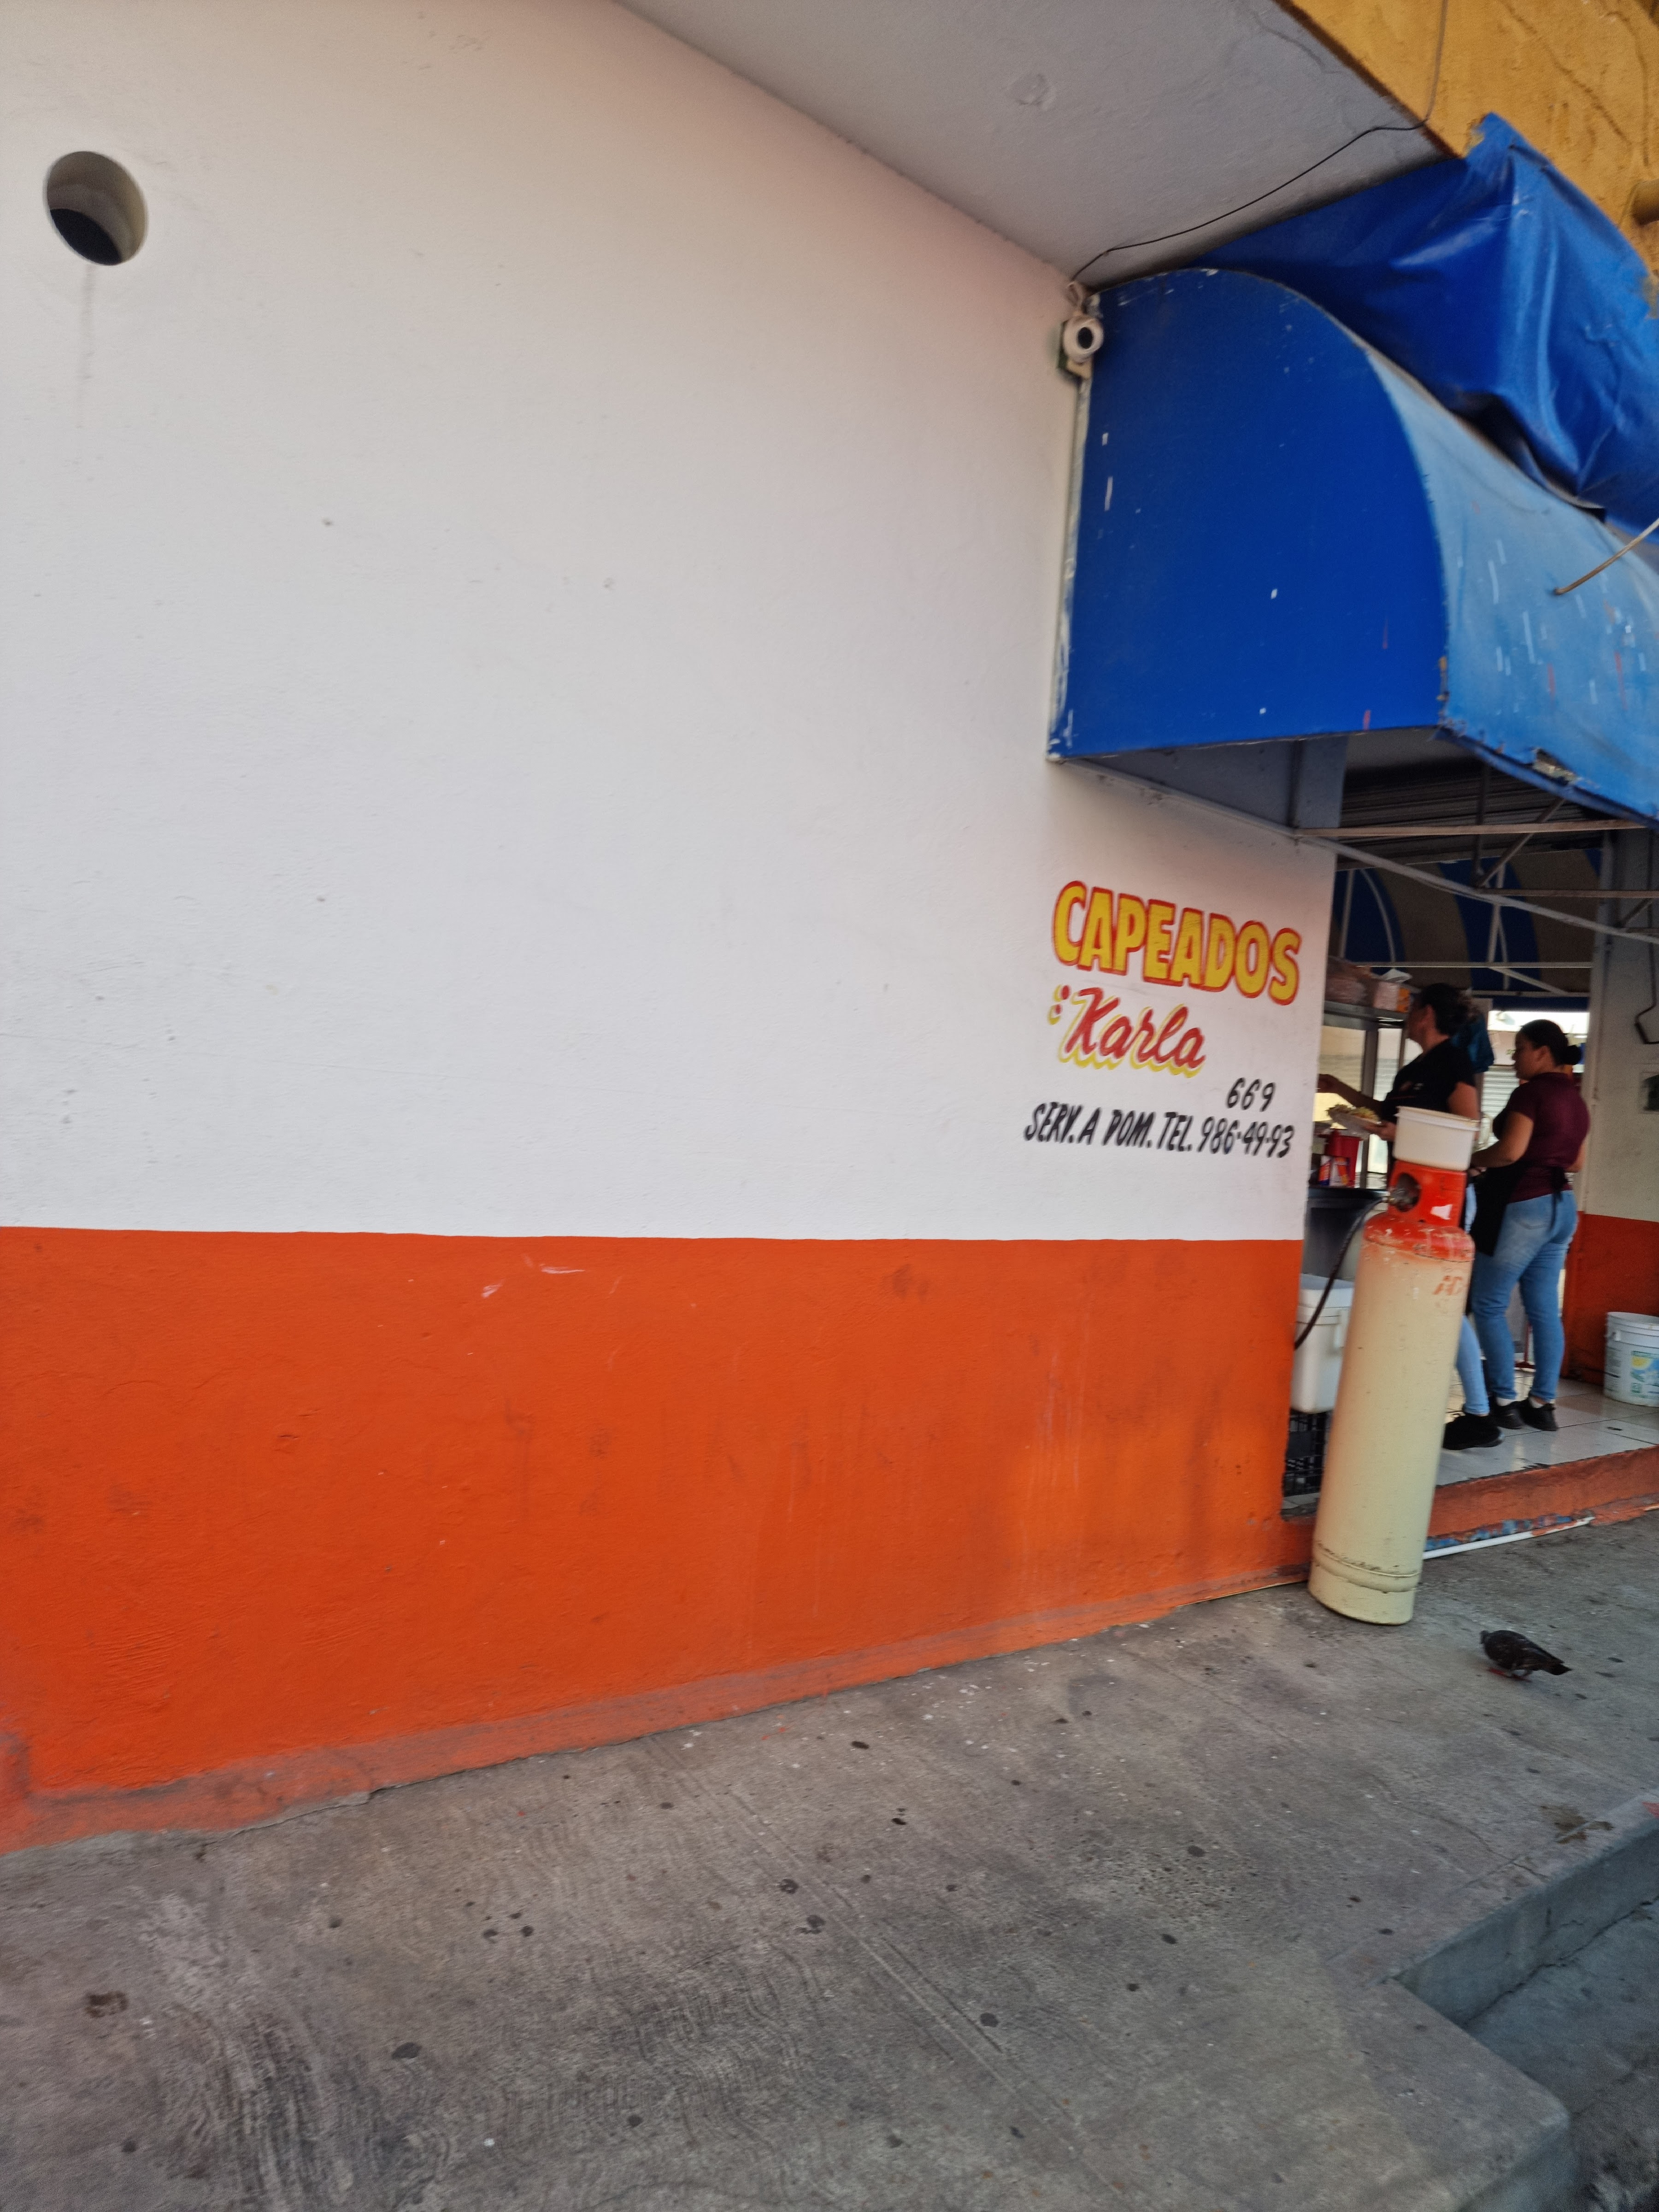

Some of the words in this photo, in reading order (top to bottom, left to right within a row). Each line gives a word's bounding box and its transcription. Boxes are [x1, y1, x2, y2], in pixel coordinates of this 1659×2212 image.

[1053, 881, 1301, 1005] CAPEADOS
[1059, 987, 1206, 1078] Karla
[1226, 1077, 1275, 1112] 669
[1076, 1106, 1102, 1145] A
[1156, 1112, 1194, 1152] TEL.
